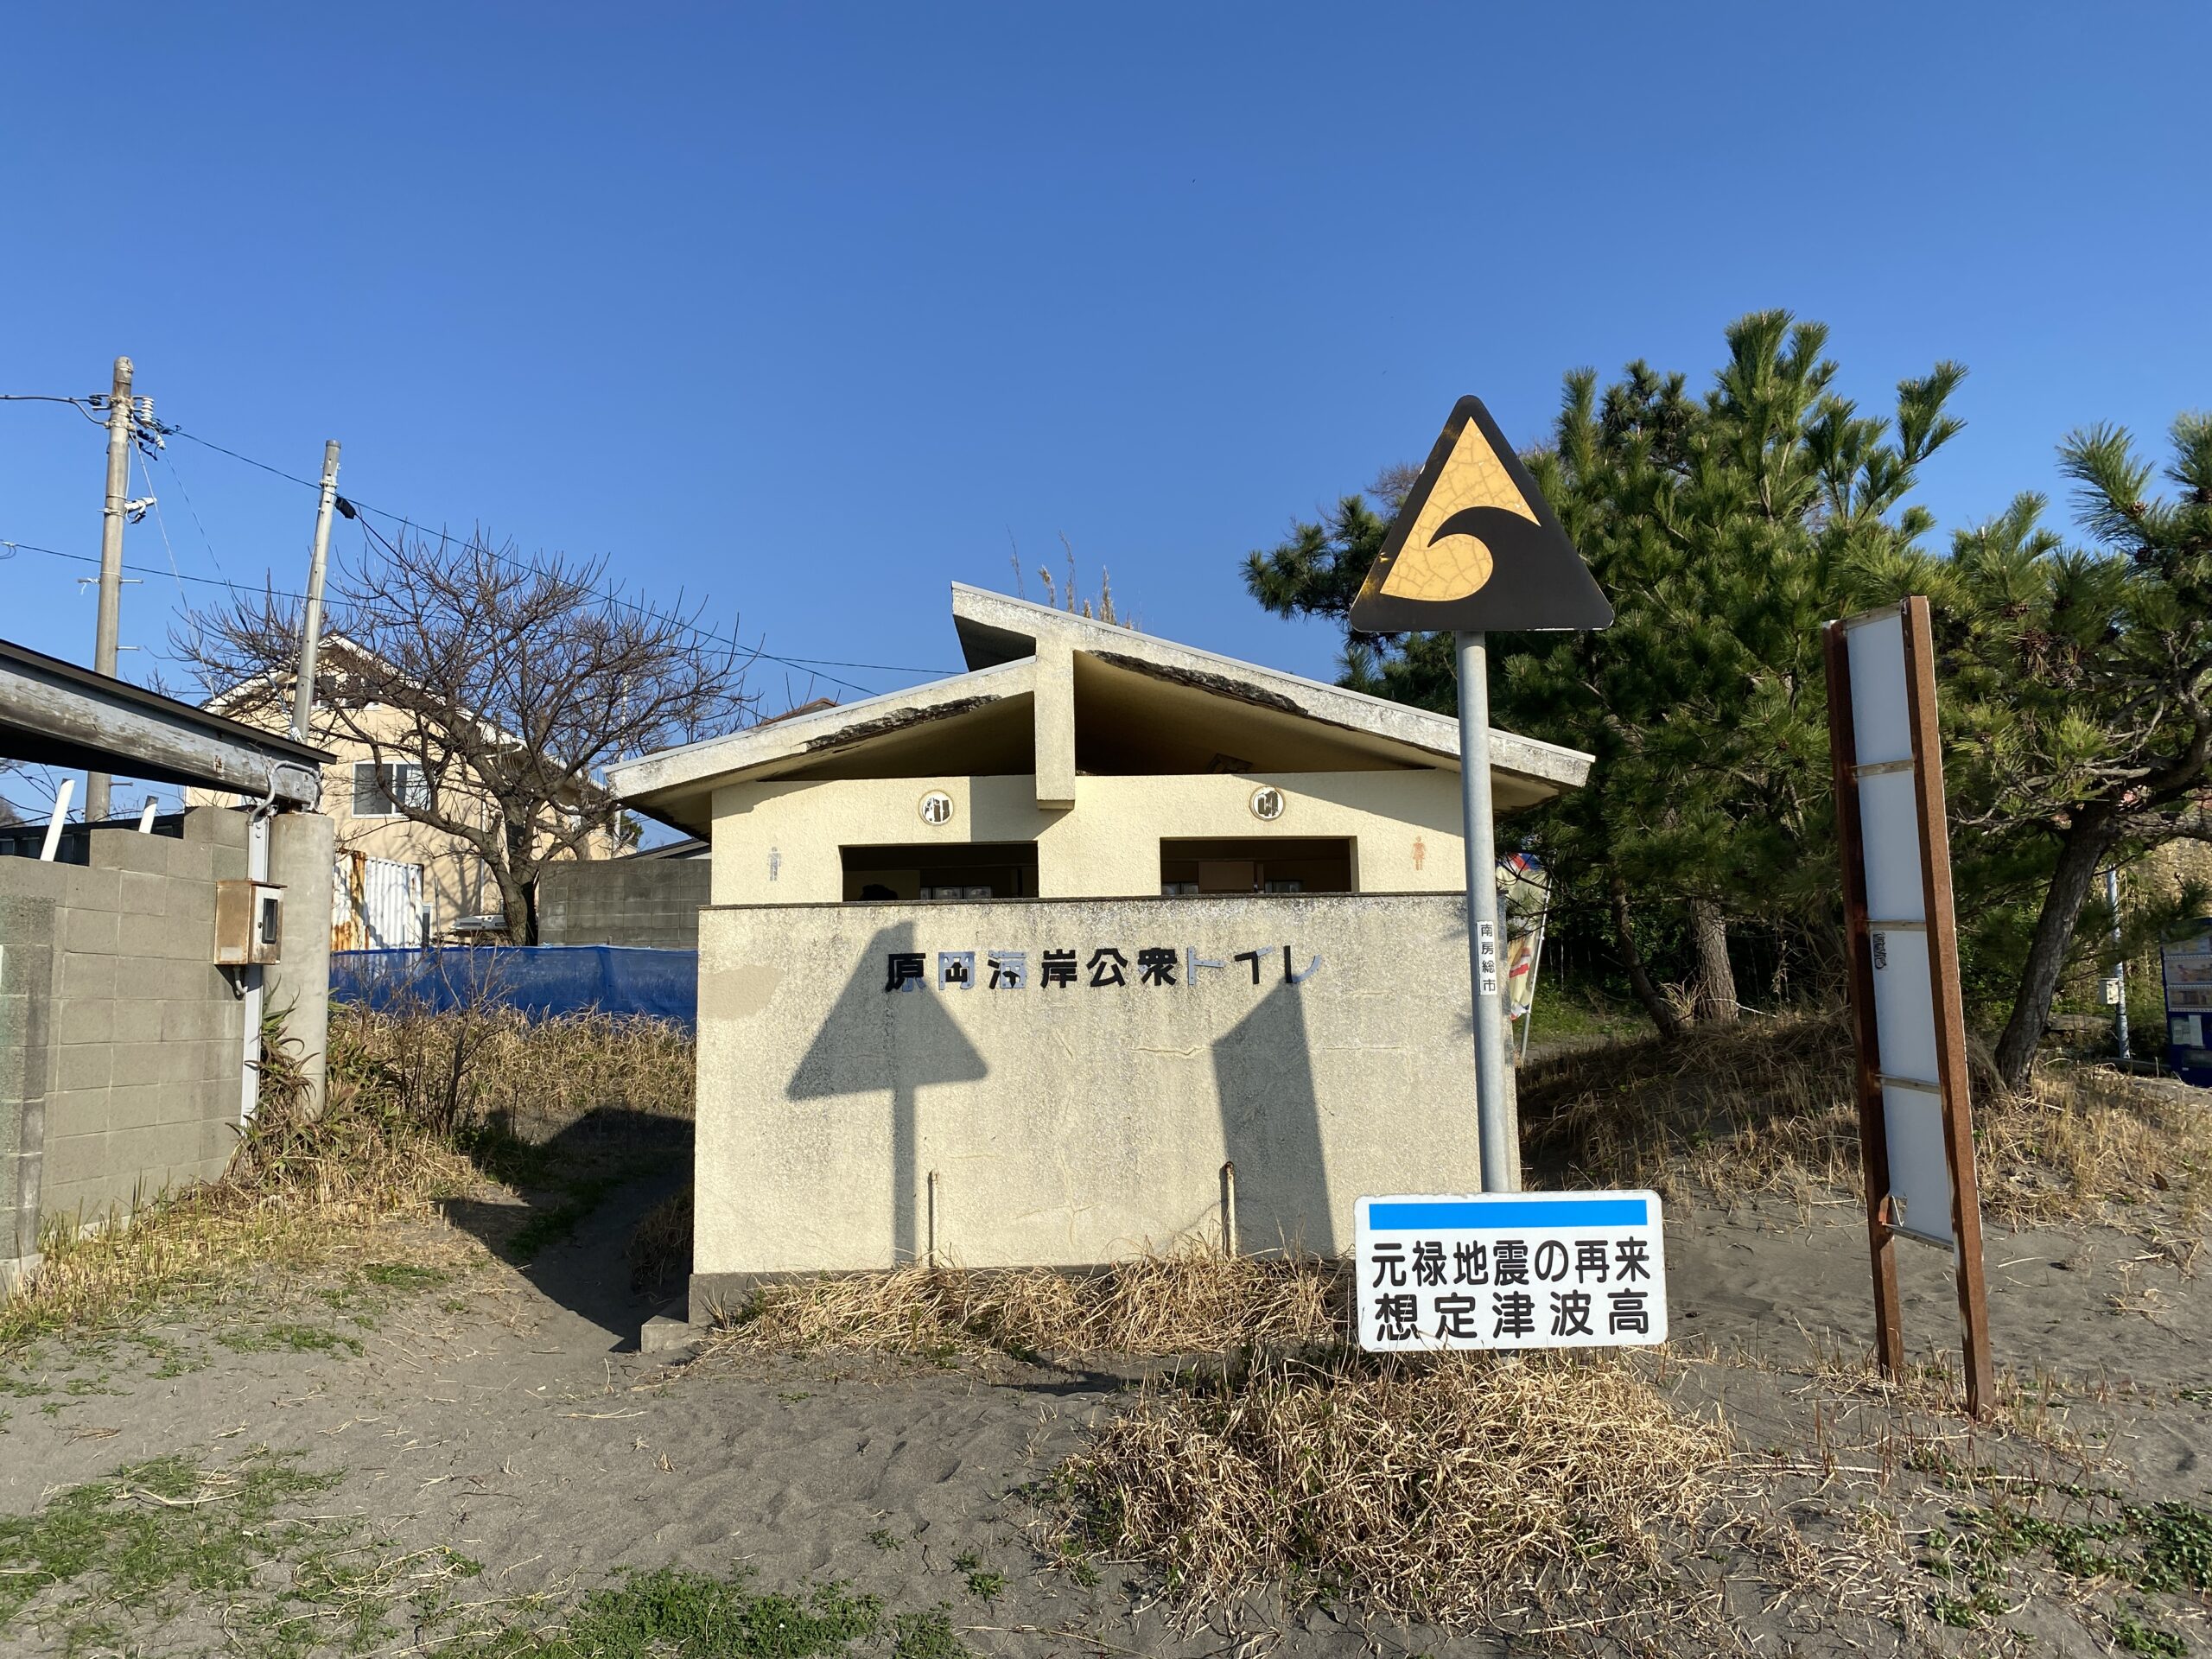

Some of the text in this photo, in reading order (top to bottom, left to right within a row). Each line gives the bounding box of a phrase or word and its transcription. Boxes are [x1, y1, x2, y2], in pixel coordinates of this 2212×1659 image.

[885, 944, 1322, 993] 原岡海岸公衆トイレ
[1480, 923, 1497, 992] 南房総市
[1371, 1236, 1651, 1288] 元禄地震の再来
[1375, 1287, 1649, 1342] 想定津波高
